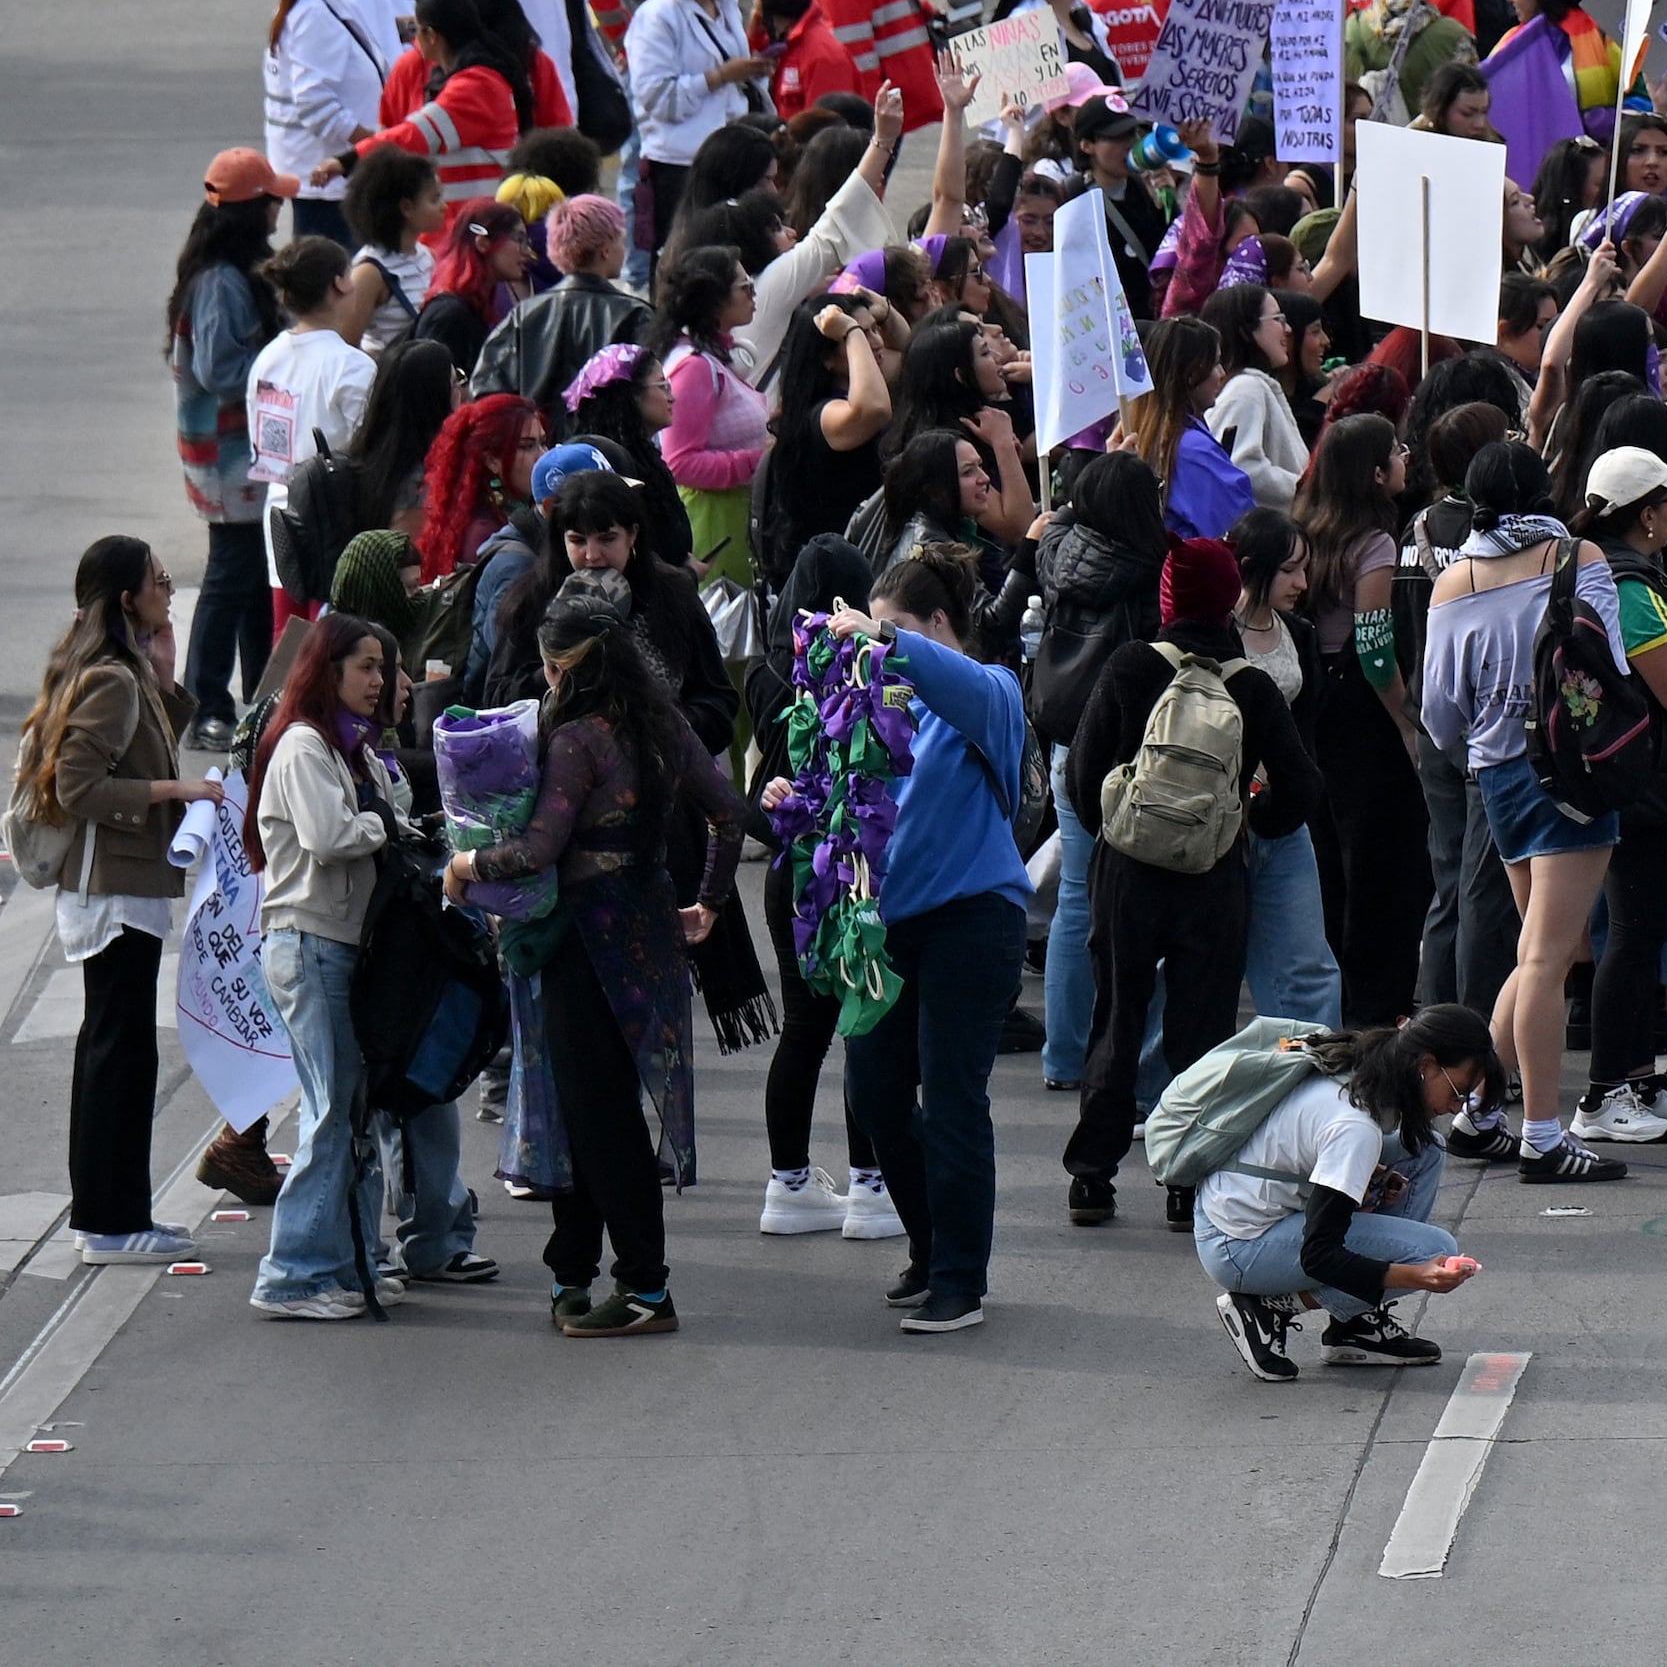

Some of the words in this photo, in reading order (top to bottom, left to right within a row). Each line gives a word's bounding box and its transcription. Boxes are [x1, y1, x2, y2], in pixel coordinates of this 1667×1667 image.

[964, 30, 986, 52] LAS
[1040, 42, 1058, 62] EN
[1157, 18, 1186, 59] LAS
[1170, 60, 1239, 102] SEREMOS
[1296, 105, 1333, 124] TODAS
[217, 805, 251, 878] QUIERO
[222, 924, 244, 963] DEL
[208, 931, 231, 970] QUE
[231, 976, 250, 1002] SU
[250, 1002, 273, 1039] VOZ
[210, 976, 257, 1048] CAMBIAR
